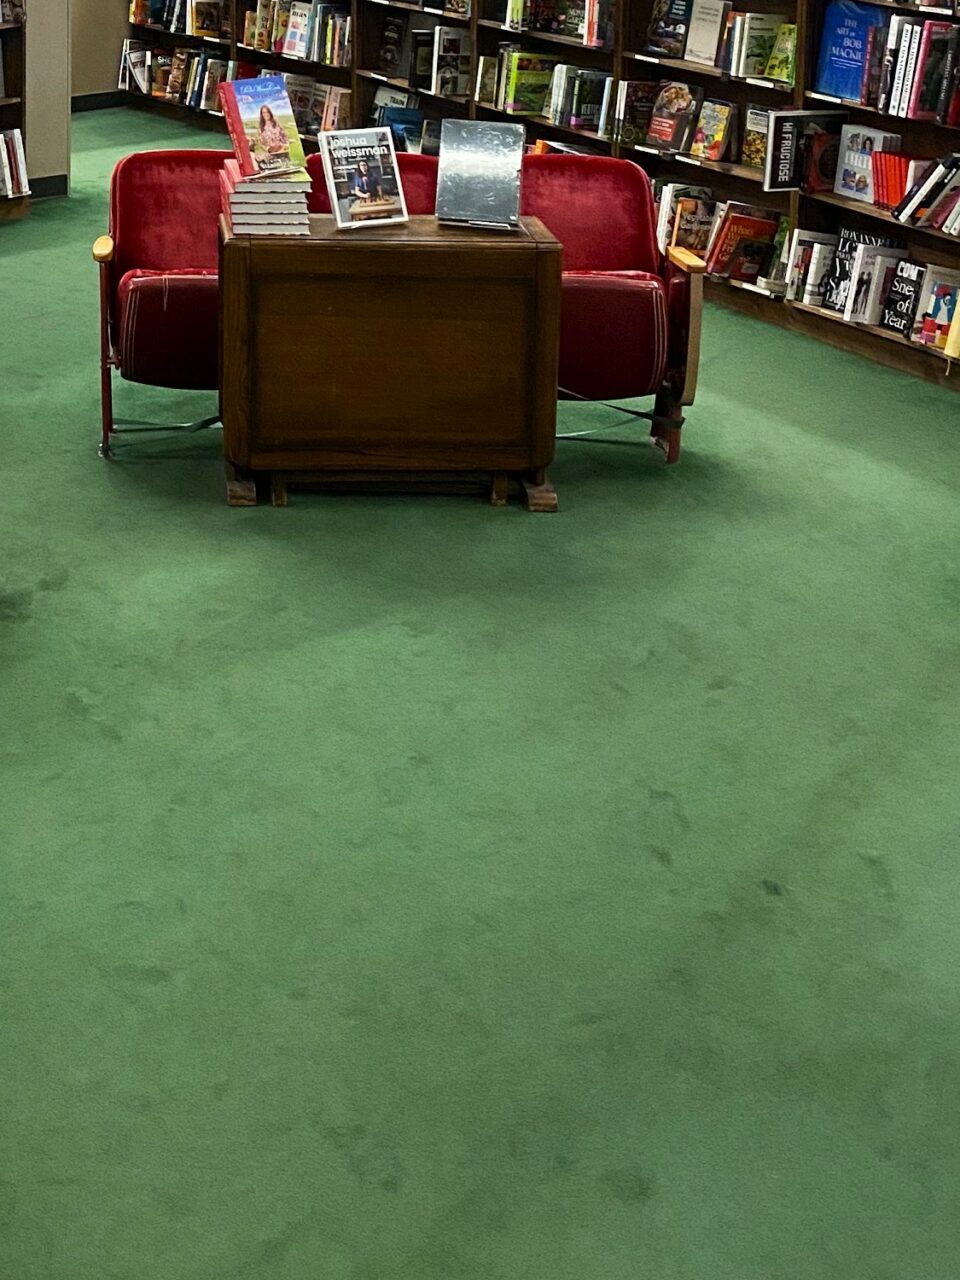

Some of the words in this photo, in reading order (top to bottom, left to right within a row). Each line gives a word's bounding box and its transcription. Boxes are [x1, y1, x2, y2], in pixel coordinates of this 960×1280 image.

[843, 38, 862, 49] BOB
[329, 136, 367, 150] joshua
[332, 145, 388, 158] weissman
[778, 133, 793, 182] FRUCTOSE
[884, 309, 907, 330] Year
